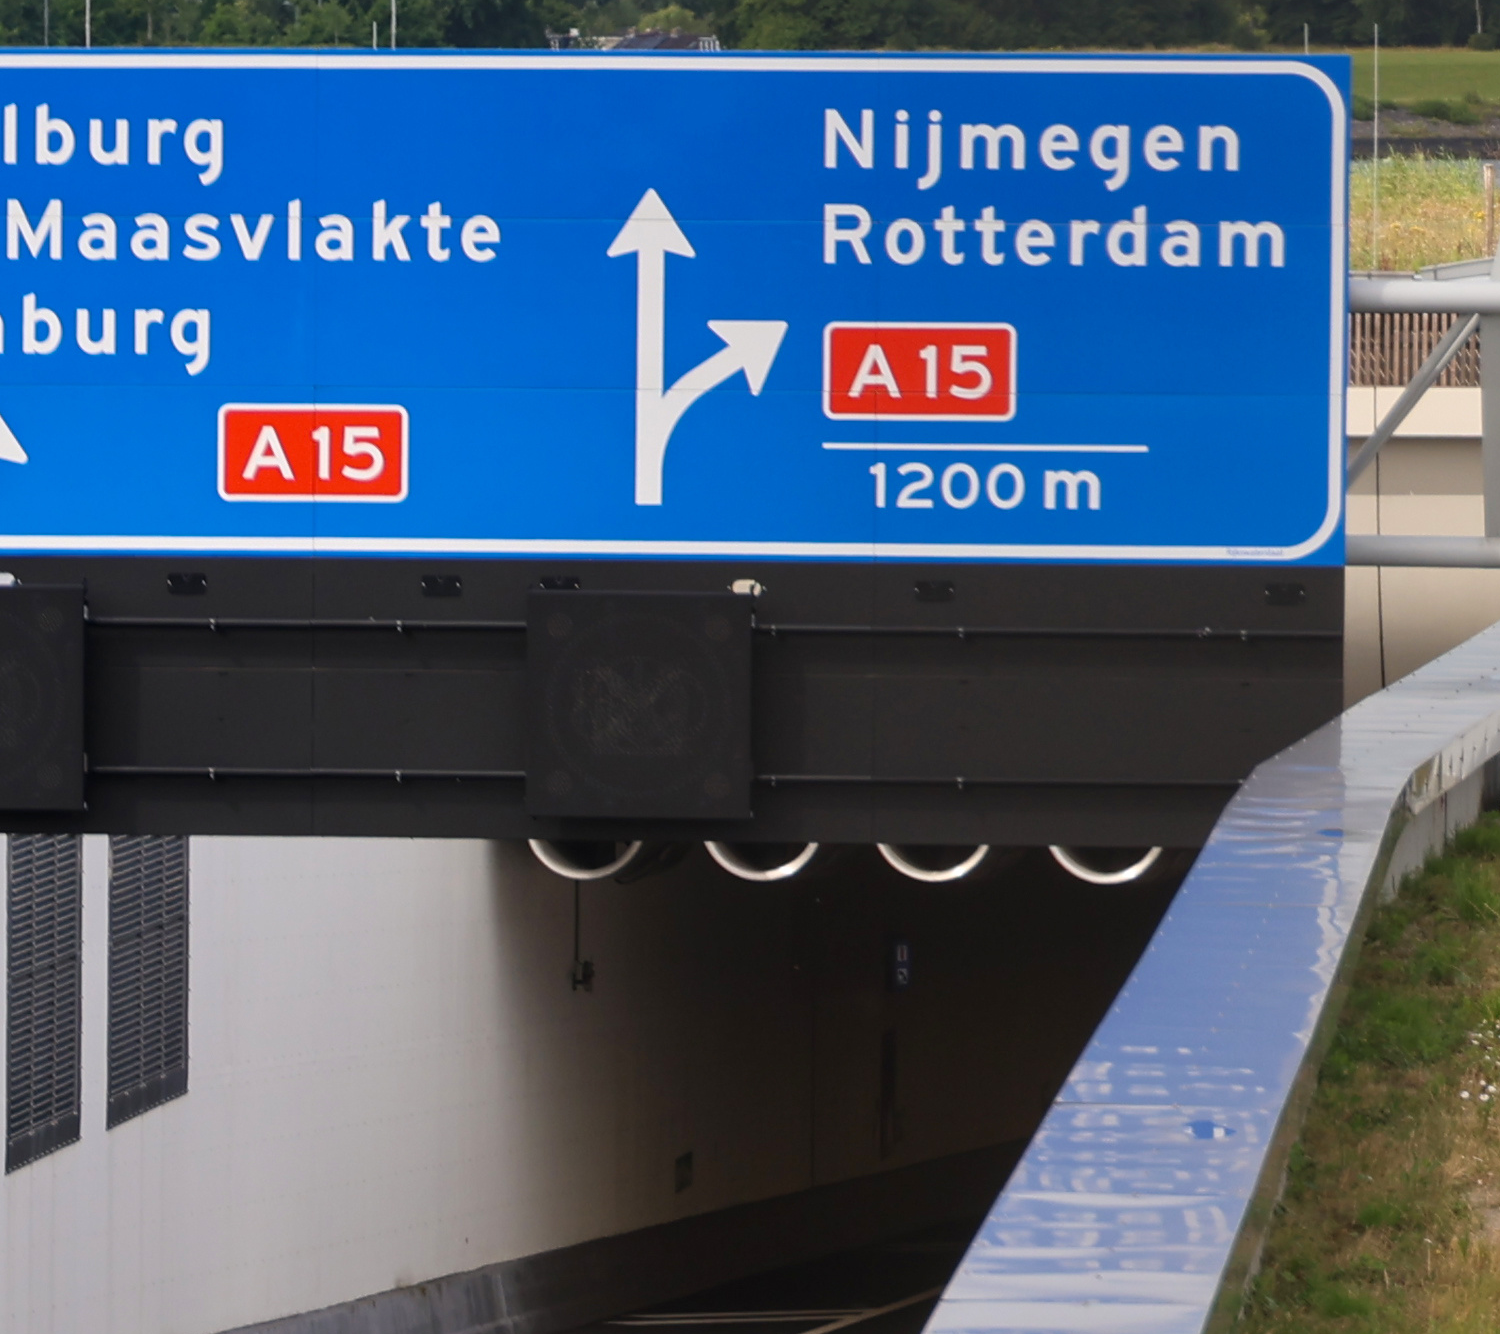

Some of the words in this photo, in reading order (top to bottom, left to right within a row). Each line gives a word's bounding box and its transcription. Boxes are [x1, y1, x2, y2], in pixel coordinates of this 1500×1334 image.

[823, 107, 1240, 192] Nijmegen
[5, 198, 502, 263] Maasvlakte
[823, 202, 1285, 268] Rotterdam
[868, 461, 1026, 510] 1200
[1043, 469, 1101, 511] m
